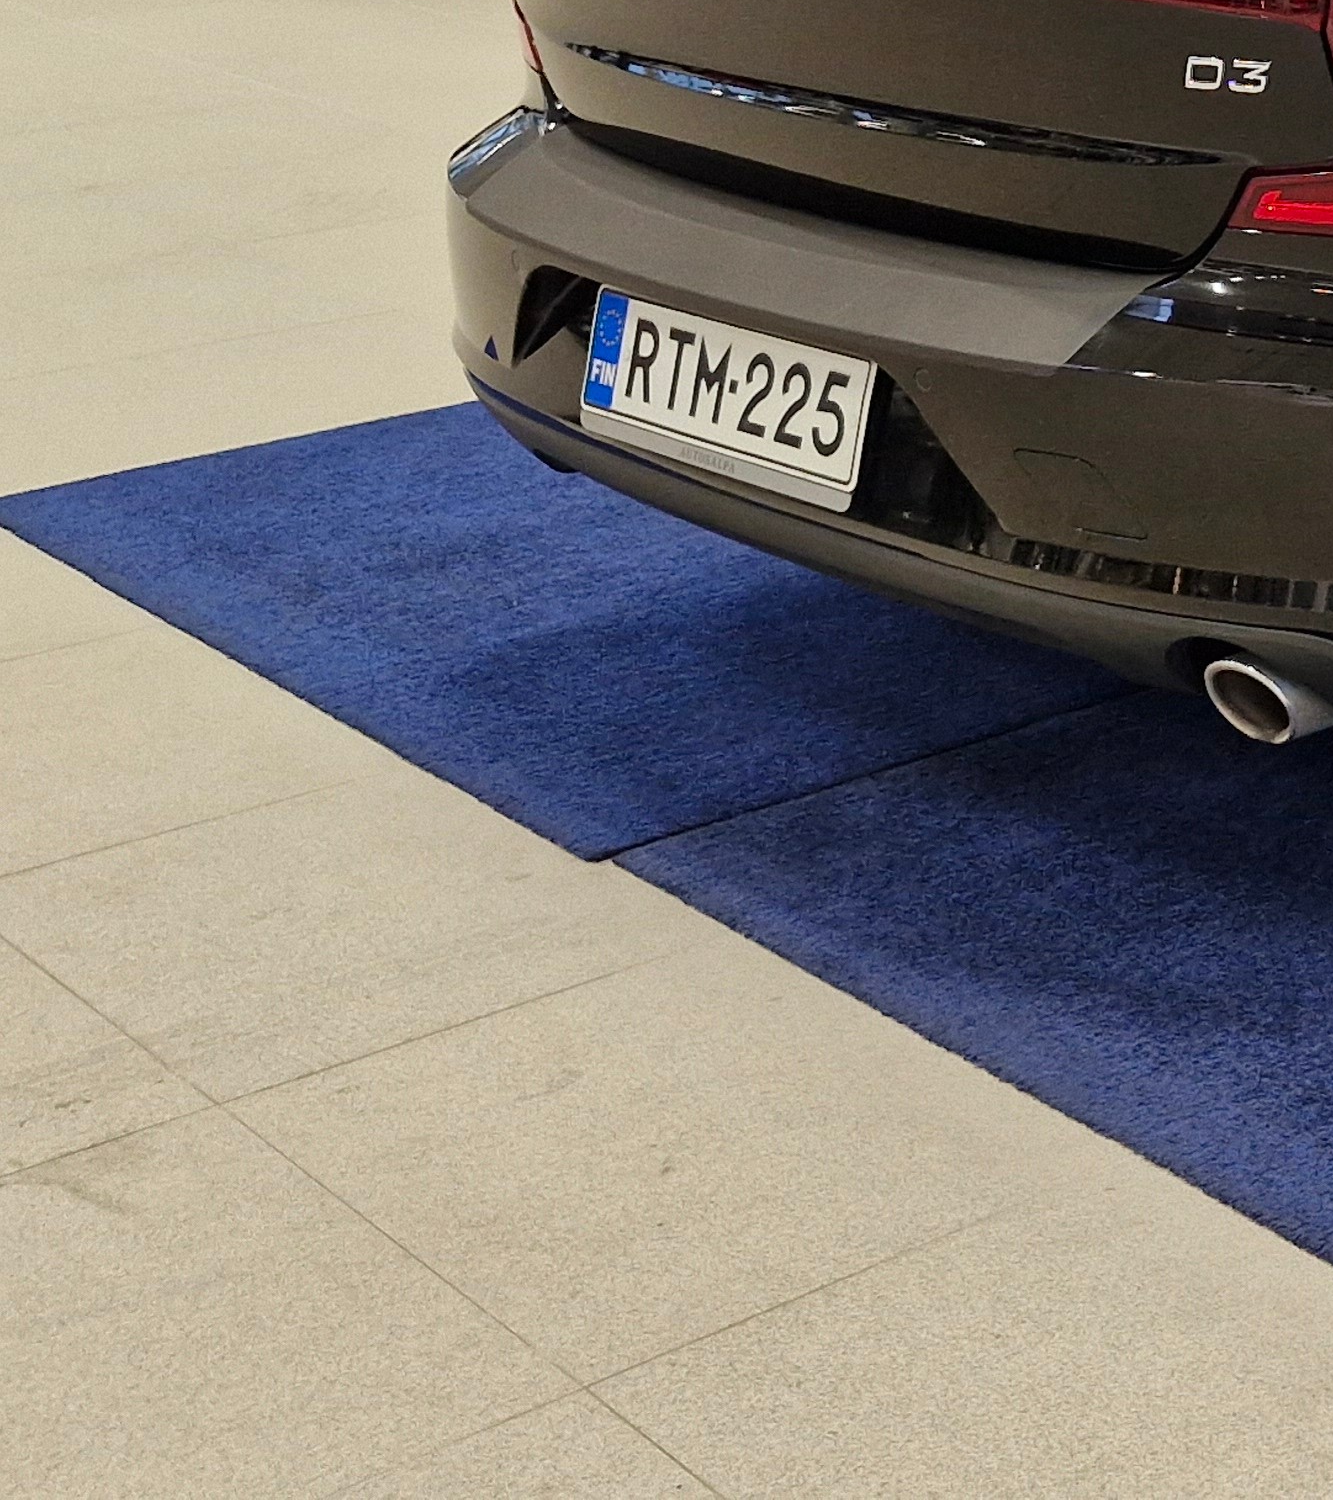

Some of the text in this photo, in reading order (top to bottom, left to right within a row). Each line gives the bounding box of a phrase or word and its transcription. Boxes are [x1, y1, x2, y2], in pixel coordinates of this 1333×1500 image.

[1184, 55, 1273, 94] D3
[591, 357, 617, 388] FIN
[625, 317, 851, 457] RTM-225
